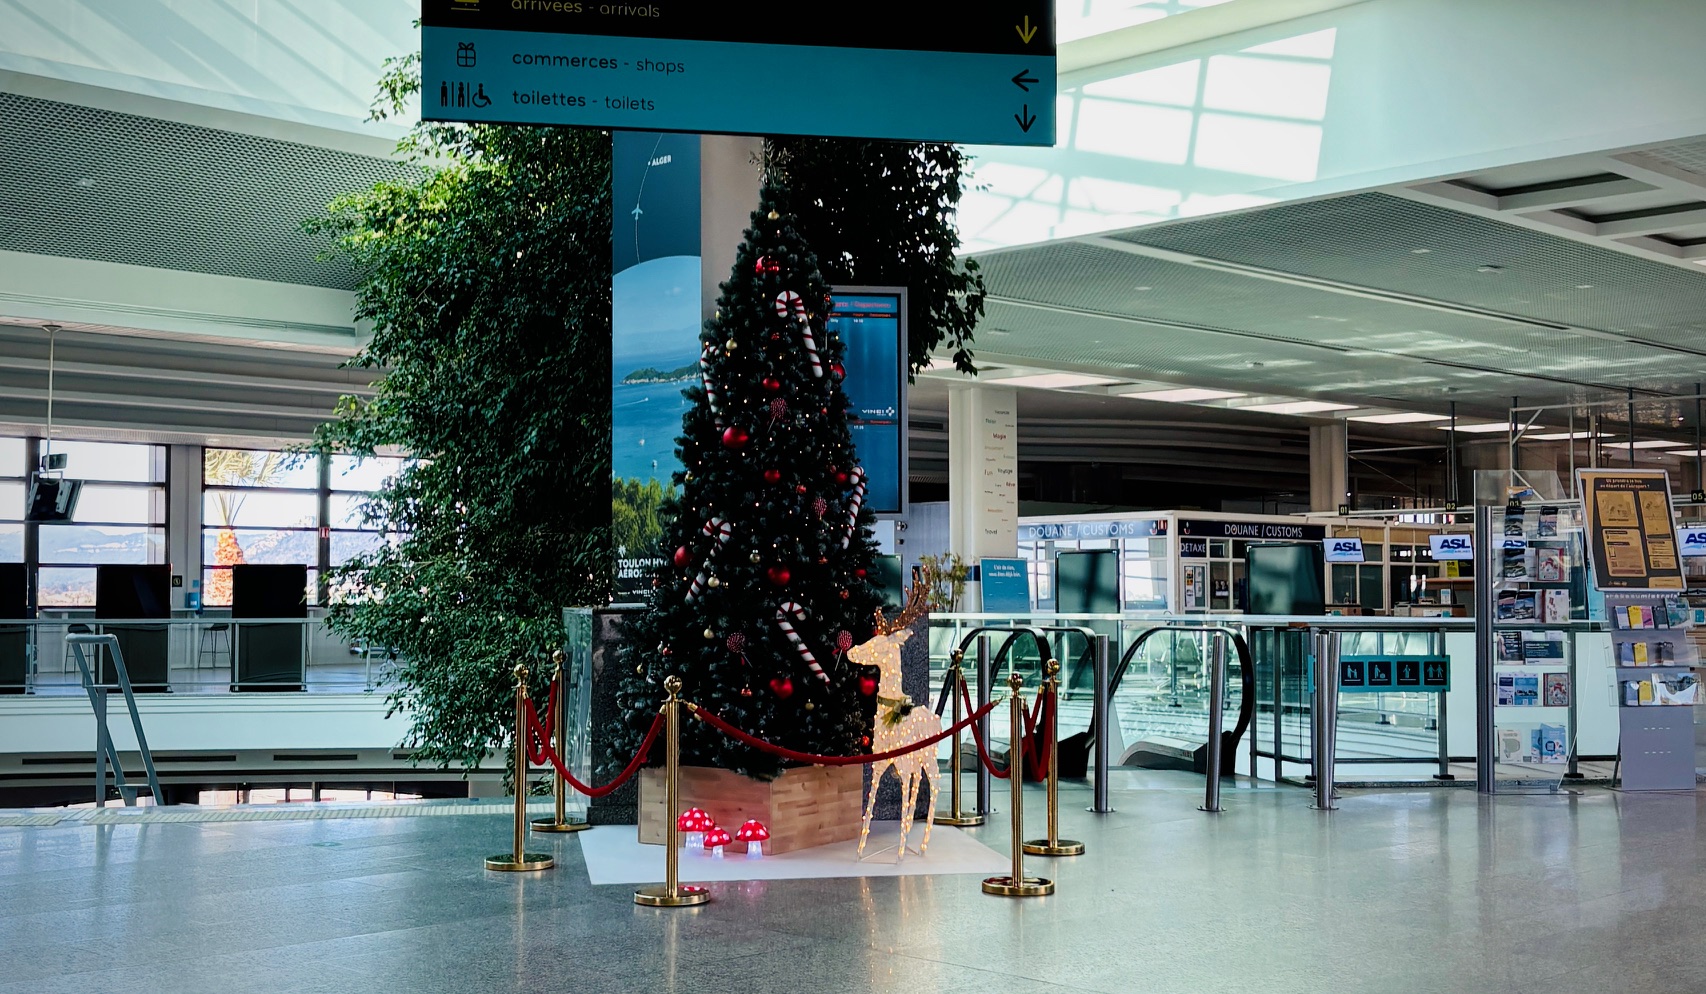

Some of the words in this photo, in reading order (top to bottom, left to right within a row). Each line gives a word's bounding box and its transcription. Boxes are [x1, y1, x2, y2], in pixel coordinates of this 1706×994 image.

[600, 3, 660, 17] arrivals
[512, 53, 618, 69] commerces
[636, 58, 685, 76] shops
[512, 90, 586, 107] toilettes
[605, 96, 655, 110] toilets
[651, 155, 672, 166] ALGER
[1340, 506, 1348, 514] 01
[1446, 502, 1455, 510] 02
[1029, 525, 1072, 538] DOUANE
[1082, 523, 1134, 536] CUSTOMS
[1224, 524, 1259, 536] DOUANE
[1266, 525, 1303, 537] CUSTOMS
[1440, 538, 1470, 549] ASL
[1685, 532, 1706, 544] AS
[1181, 542, 1206, 553] DETAXE
[1333, 542, 1361, 551] ASL
[618, 558, 651, 568] TOULON
